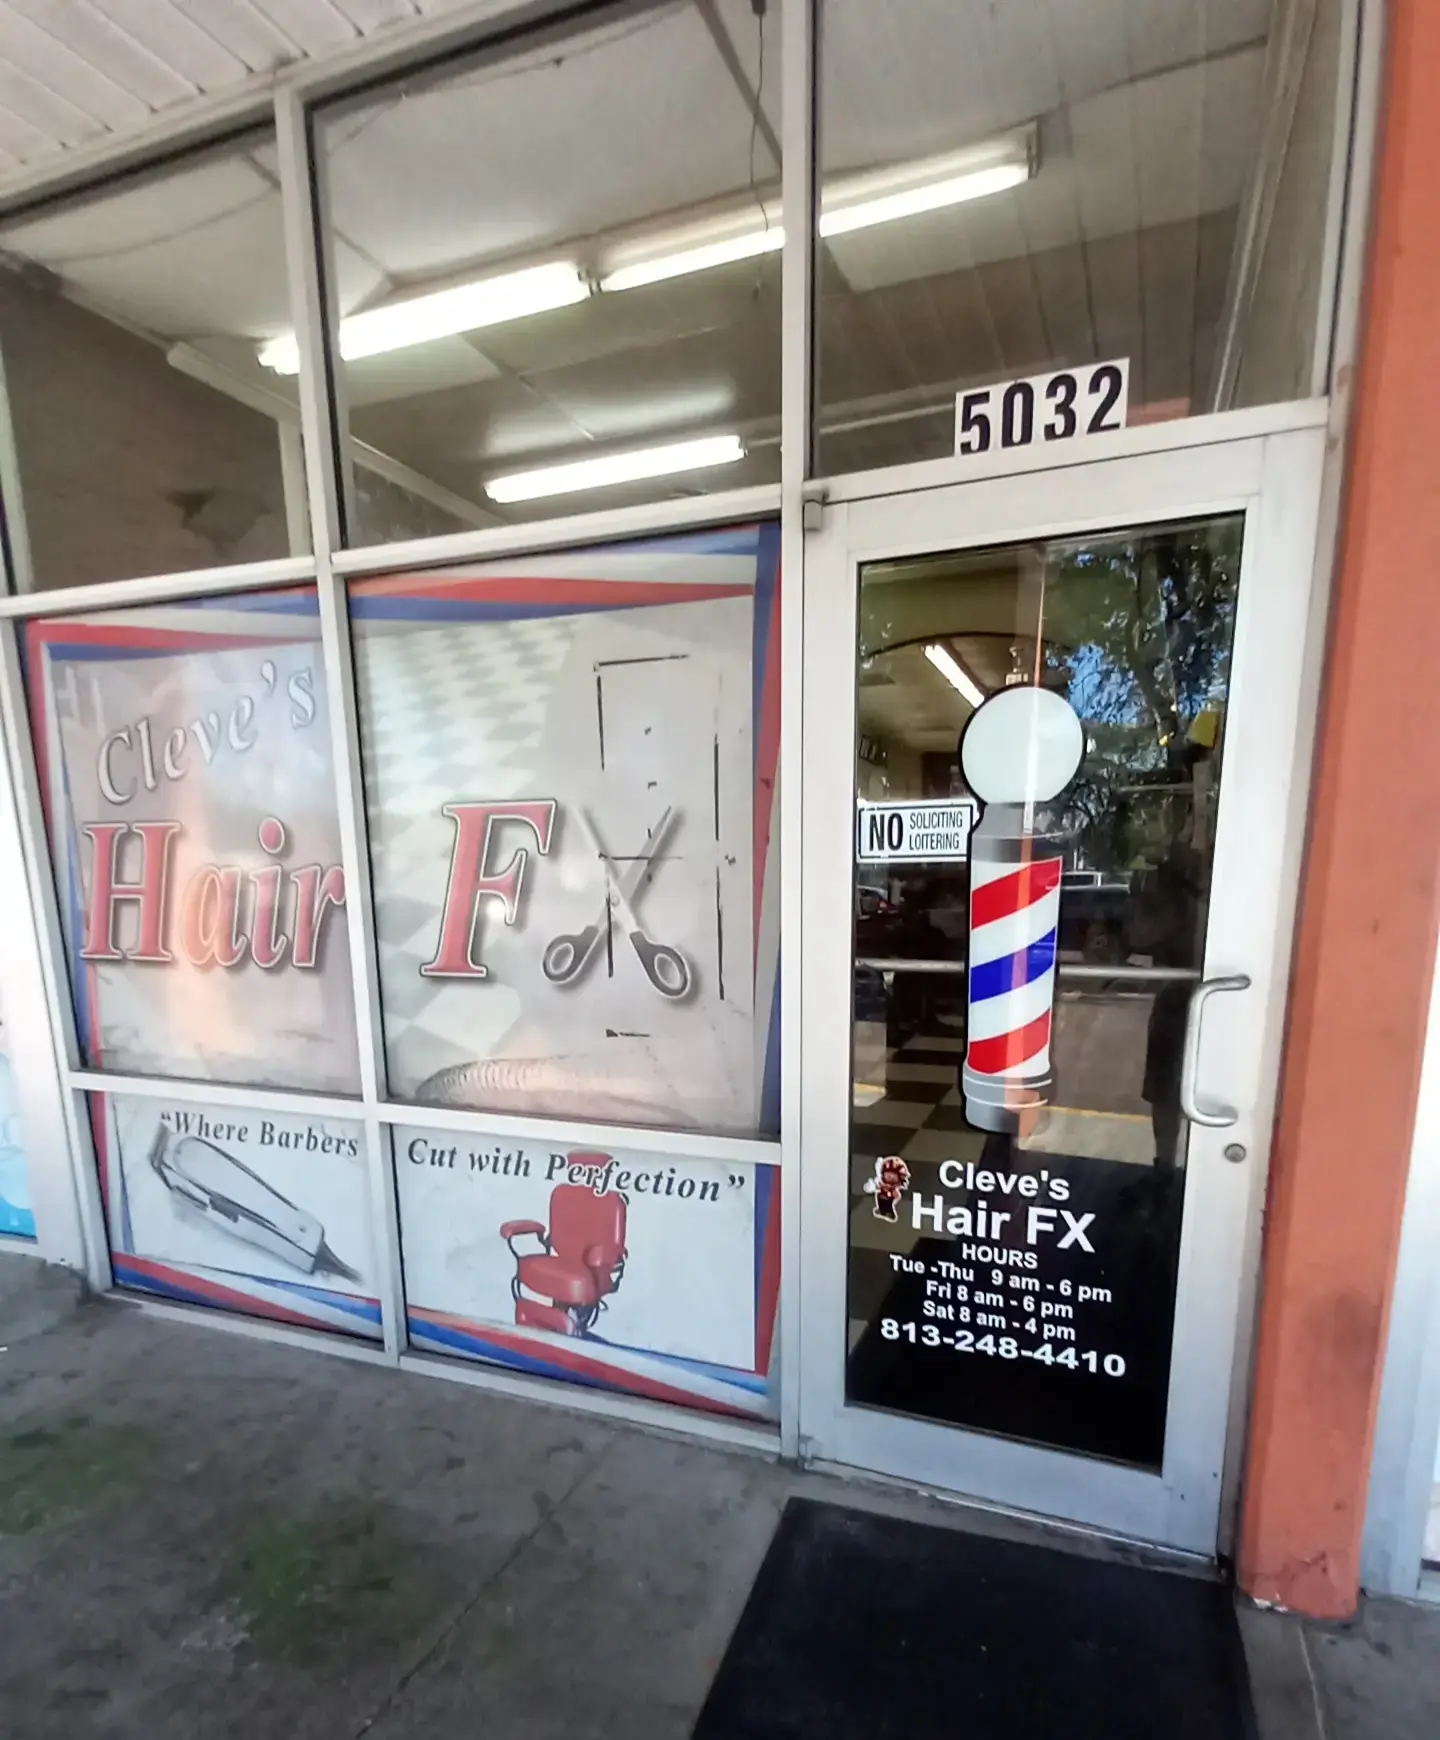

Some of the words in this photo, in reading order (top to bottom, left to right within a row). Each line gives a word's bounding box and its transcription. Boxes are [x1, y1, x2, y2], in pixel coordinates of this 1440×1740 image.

[960, 365, 1122, 455] 5032
[869, 812, 904, 851] NO
[909, 811, 963, 829] SOLICITING
[909, 832, 960, 850] LOITERING
[80, 817, 347, 968] Hair
[260, 1120, 360, 1157] Barbers
[407, 1138, 457, 1168] Cut
[469, 1147, 531, 1177] with
[939, 1160, 1070, 1200] Cleve's
[911, 1192, 1011, 1240] Hair
[1026, 1206, 1097, 1253] FX
[889, 1254, 925, 1274] Tue
[991, 1269, 1003, 1286] 9
[1009, 1276, 1040, 1292] am
[1059, 1279, 1072, 1296] 6
[1078, 1285, 1112, 1303] pm
[962, 1243, 1038, 1269] HOURS
[923, 1300, 955, 1320] Sat
[959, 1306, 971, 1322] 8
[976, 1313, 1006, 1329] am
[1025, 1318, 1037, 1334] 4
[1043, 1324, 1076, 1341] pm
[926, 1279, 951, 1299] Fri
[957, 1285, 968, 1301] 8
[974, 1291, 1004, 1307] am
[1023, 1295, 1035, 1312] 6
[1041, 1302, 1073, 1319] pm
[881, 1318, 1126, 1377] 813-248-4410
